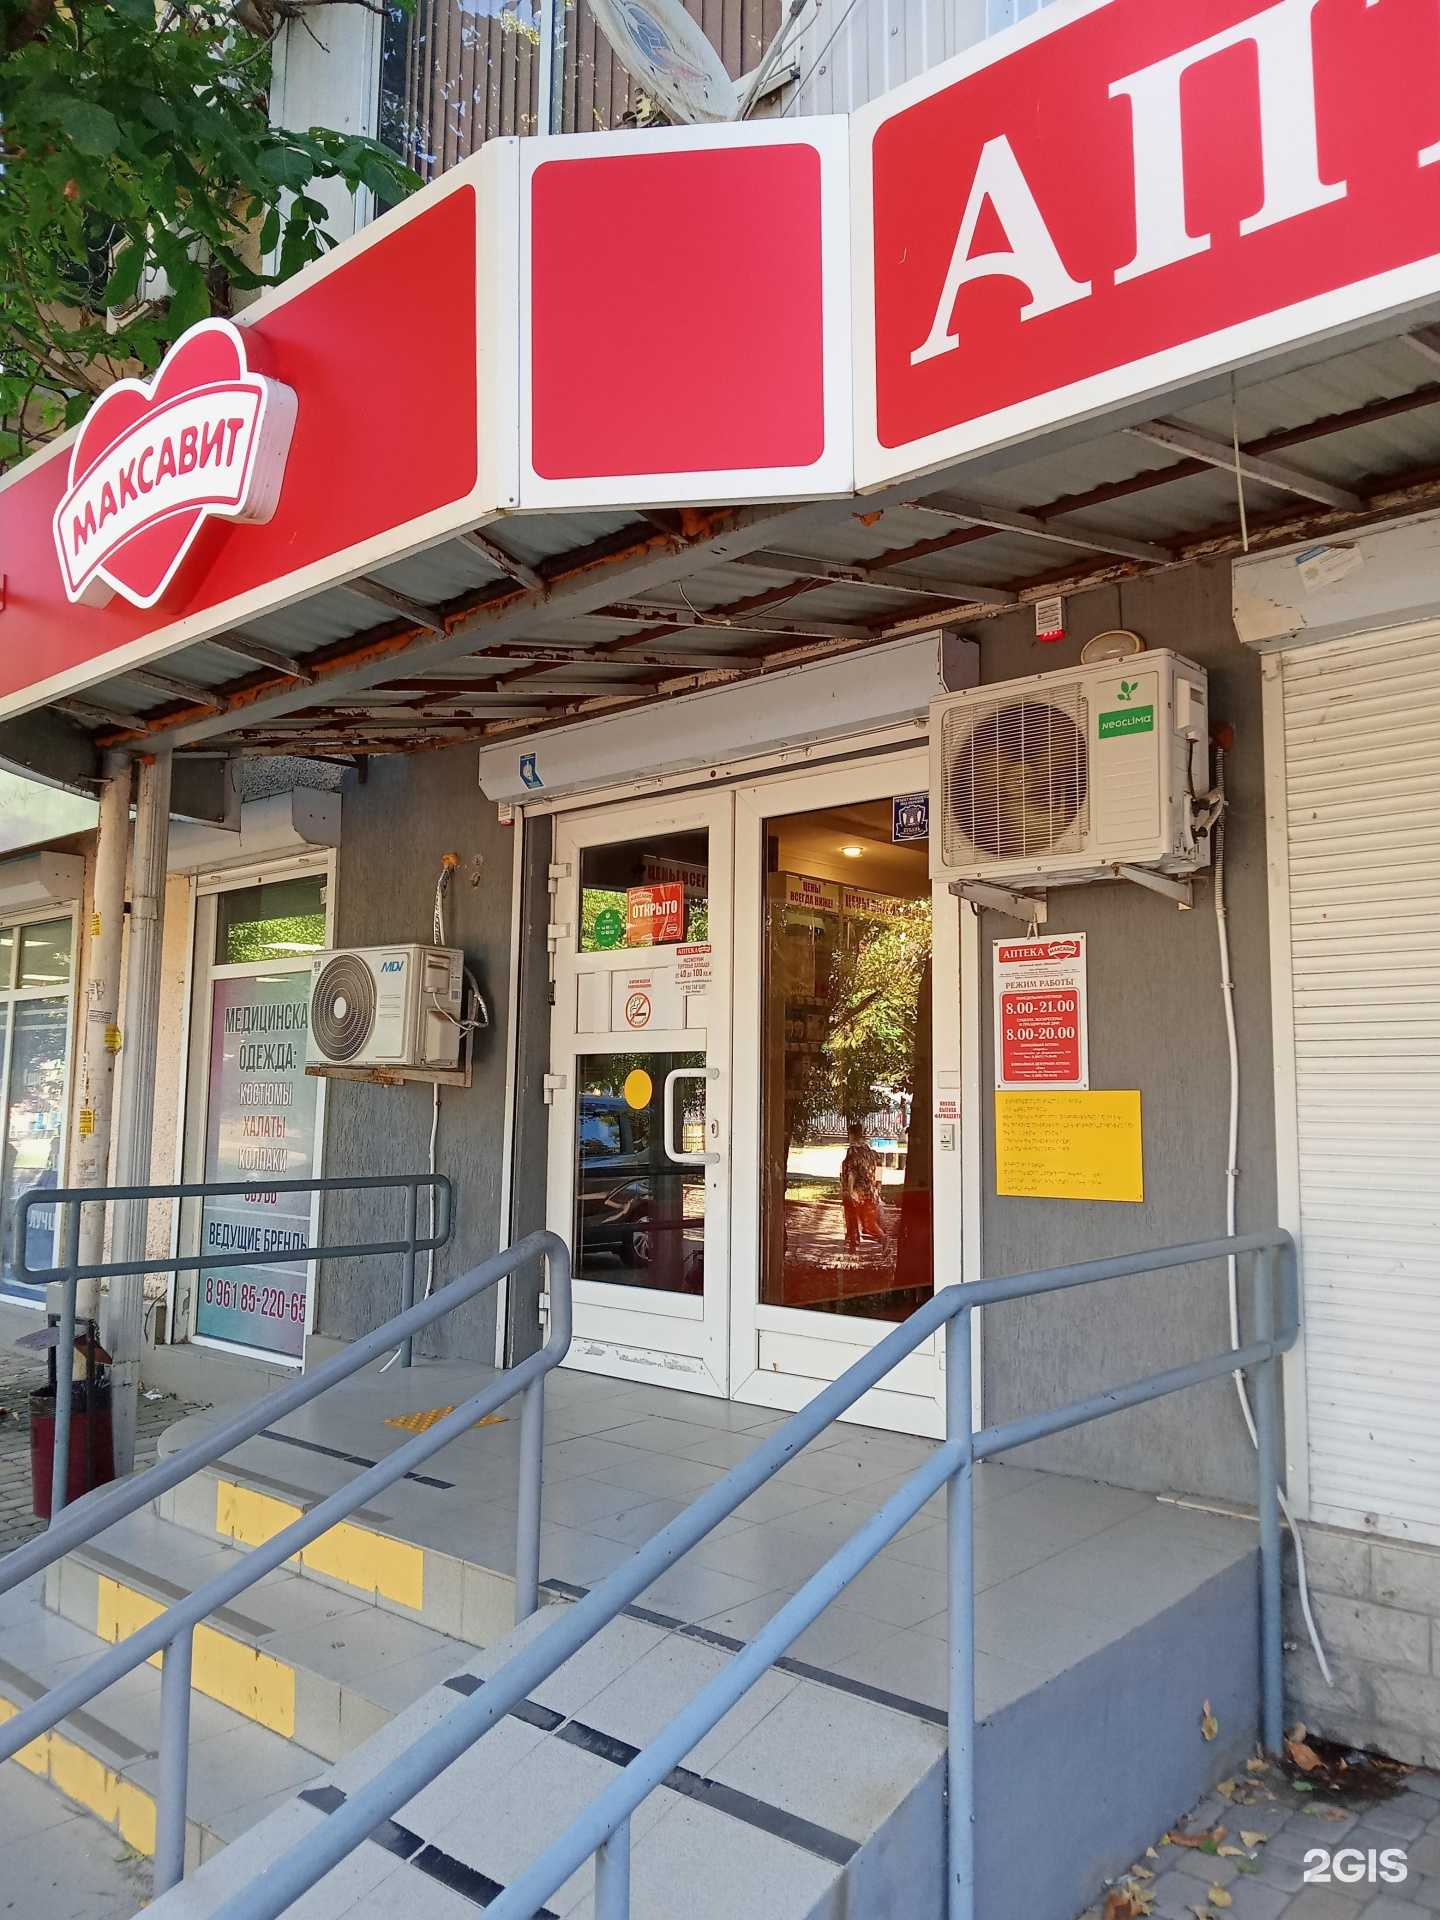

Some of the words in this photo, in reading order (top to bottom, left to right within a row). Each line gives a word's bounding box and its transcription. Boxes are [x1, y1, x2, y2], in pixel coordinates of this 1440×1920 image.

[910, 0, 1440, 367] АП
[72, 418, 244, 557] МАКСАВИТ
[802, 881, 821, 892] ЦЕНЫ
[790, 891, 813, 906] ВСЕГДА
[632, 899, 678, 919] ОТКРЫТО
[1003, 947, 1045, 959] АПТЕКА
[381, 960, 404, 973] MDV
[680, 969, 687, 977] 40
[693, 968, 702, 977] 100
[1005, 980, 1037, 989] РЕЖИМ
[1039, 978, 1075, 988] РАБОТЫ
[1005, 999, 1076, 1015] 8.00-21.00
[1006, 1026, 1076, 1041] 8.00-20.00
[239, 1043, 297, 1073] ОДЕЖДА:
[240, 1081, 293, 1106] КОСТЮМЫ
[242, 1115, 286, 1138] ХАЛАТЫ
[238, 1147, 288, 1173] КОЛПАКИ
[209, 1222, 261, 1252] ВЕДУЩИЕ
[206, 1278, 213, 1304] 8
[216, 1280, 238, 1309] 961
[241, 1284, 306, 1323] 85-220-65
